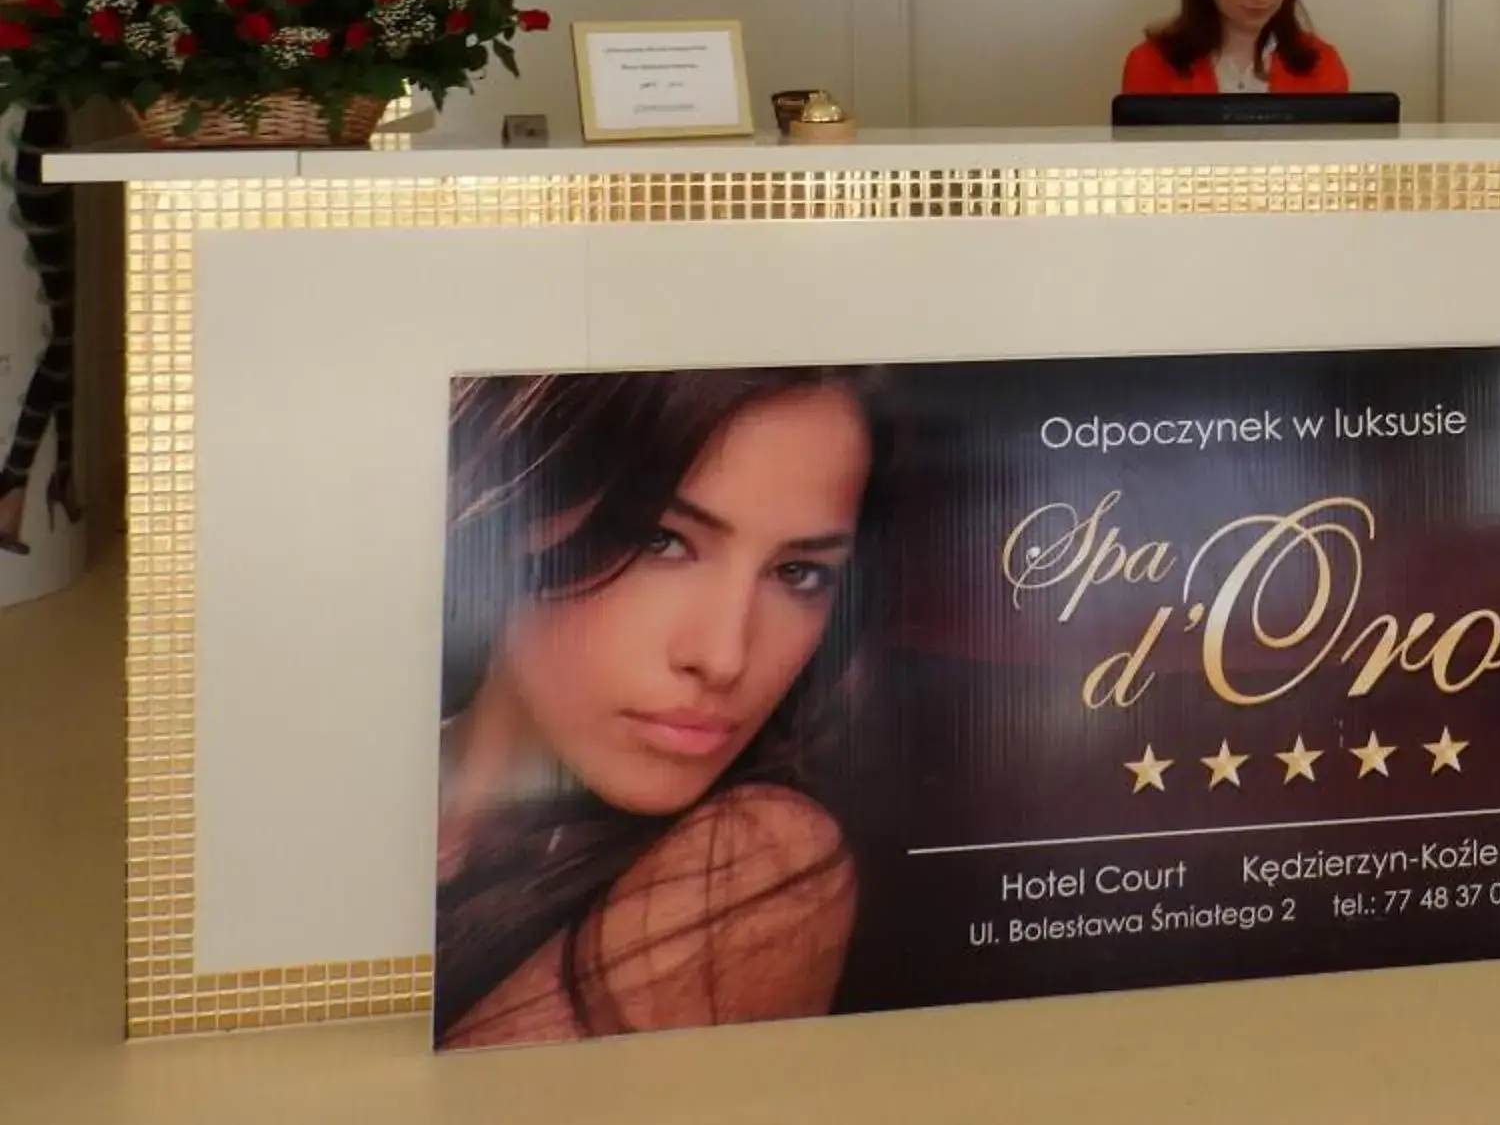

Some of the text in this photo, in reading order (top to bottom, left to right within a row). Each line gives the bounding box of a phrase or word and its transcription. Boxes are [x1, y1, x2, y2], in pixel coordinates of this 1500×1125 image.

[1040, 404, 1467, 453] Odpoczynek w luksusie
[1002, 489, 1177, 623] Spa
[1001, 837, 1500, 903] Hotel Court Kędzierzyn-Koźle
[969, 922, 1001, 948] Ul.
[1008, 911, 1143, 944] Bolesława
[1151, 902, 1274, 935] Śmiałego
[1281, 898, 1296, 923] 2
[1333, 893, 1376, 918] tel.:
[1384, 890, 1411, 914] 77
[1420, 887, 1449, 911] 48
[1456, 884, 1483, 908] 37
